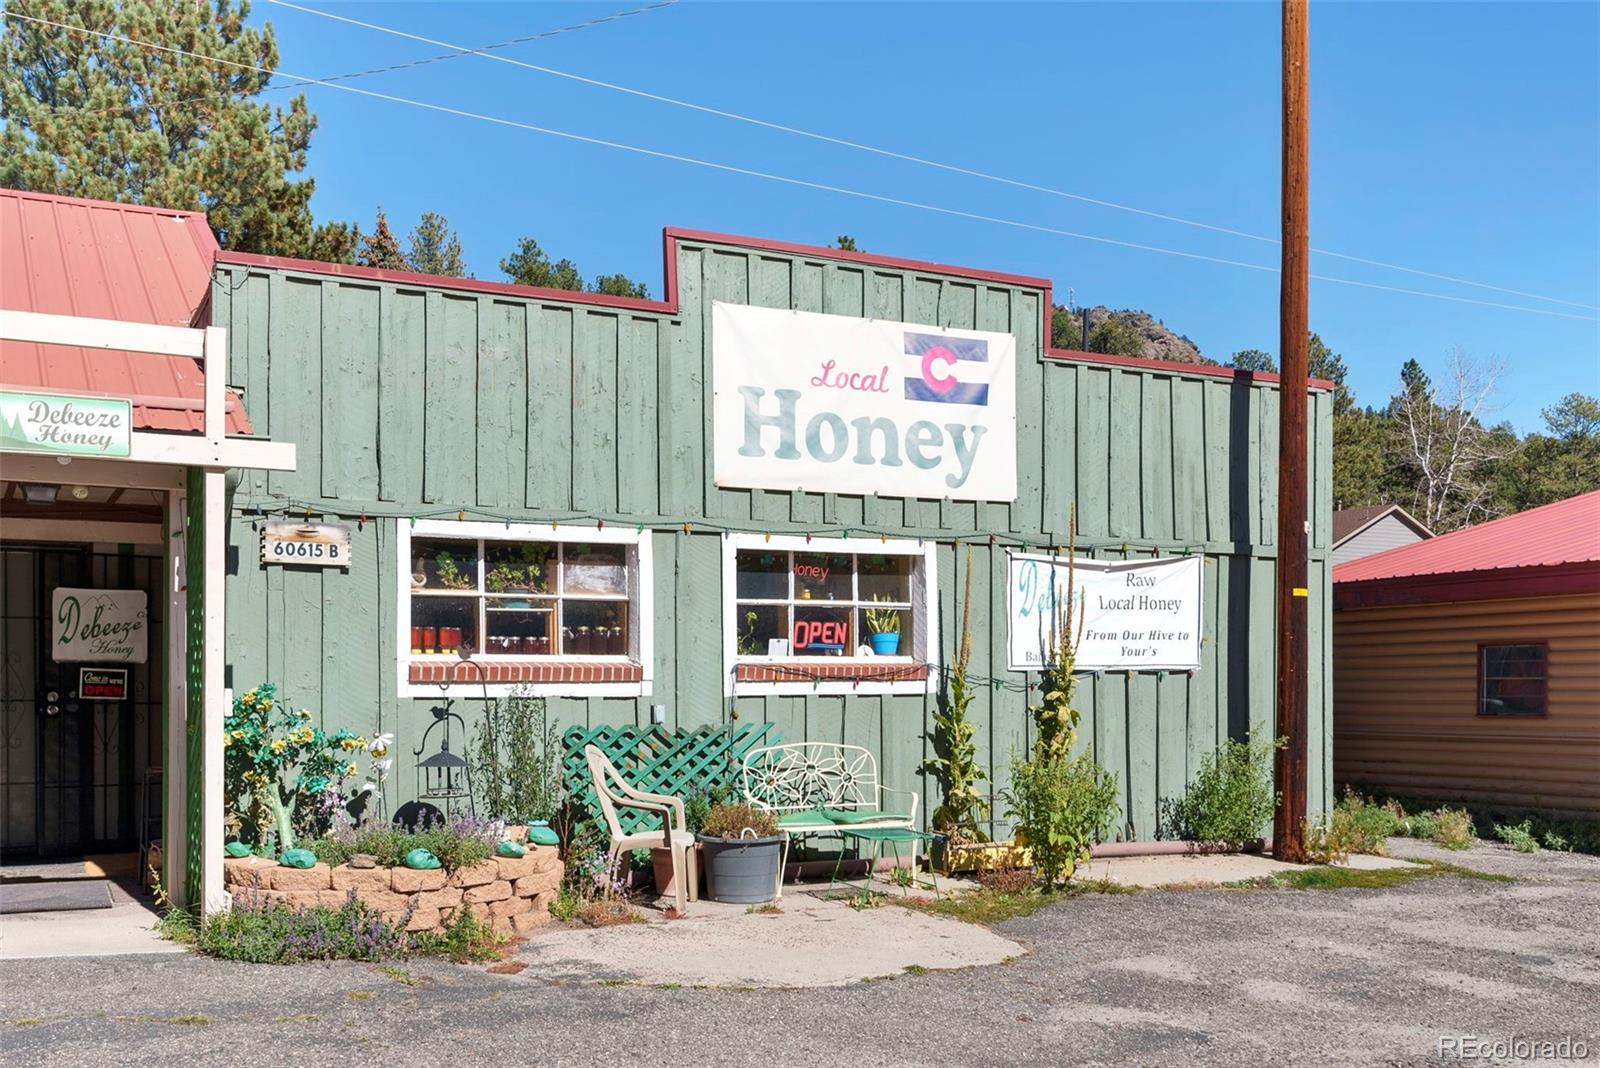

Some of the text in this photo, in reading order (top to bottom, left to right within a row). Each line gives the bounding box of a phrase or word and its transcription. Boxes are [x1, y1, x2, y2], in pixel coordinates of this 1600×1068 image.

[811, 359, 889, 393] Local
[27, 400, 121, 428] Debeeze
[35, 424, 115, 451] Honey
[737, 386, 988, 489] Honey
[274, 542, 339, 558] 60615 B
[1126, 572, 1157, 587] Raw
[1098, 595, 1182, 614] Local Honey
[58, 596, 143, 645] Debeeze
[794, 621, 848, 648] OPEN
[1086, 630, 1189, 641] From Our Hive to
[89, 638, 134, 660] Honey
[1121, 646, 1158, 657] Your's
[84, 685, 123, 696] OPEN
